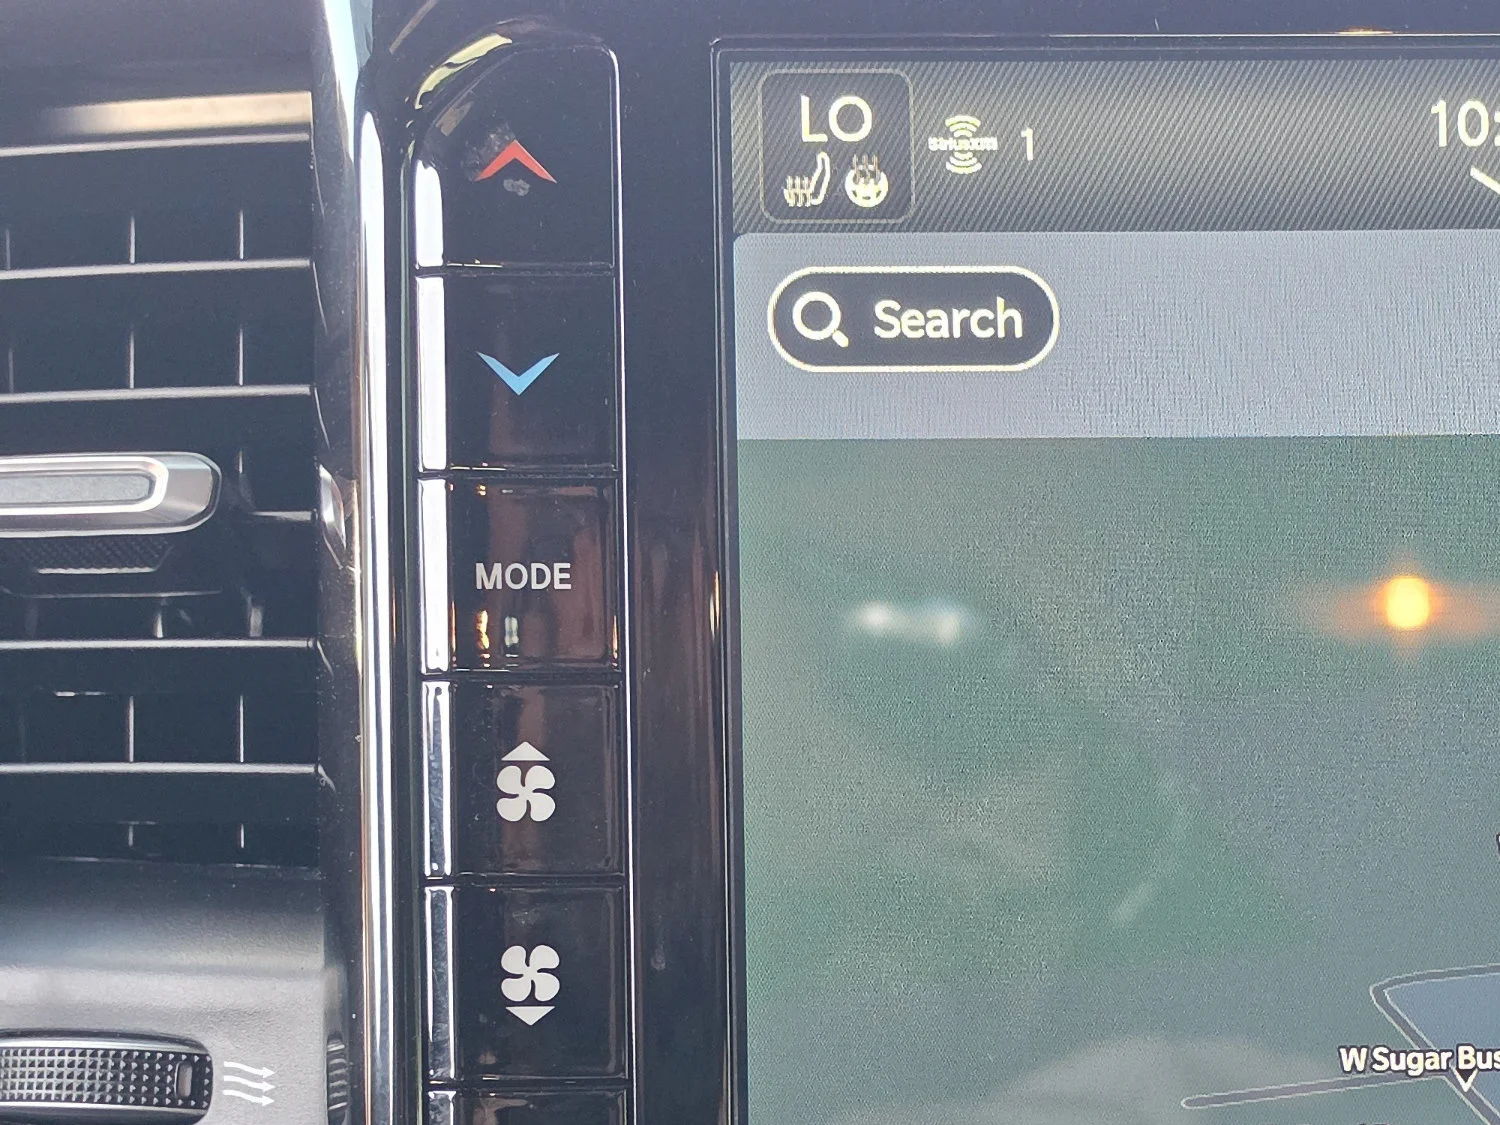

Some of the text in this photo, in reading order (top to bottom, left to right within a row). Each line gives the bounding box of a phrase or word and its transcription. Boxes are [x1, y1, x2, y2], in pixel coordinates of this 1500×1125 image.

[800, 95, 873, 144] LO
[1020, 126, 1034, 161] 1
[873, 296, 1024, 340] Search
[474, 562, 573, 591] MODE
[1338, 1047, 1367, 1072] W
[1371, 1047, 1452, 1076] Sugar
